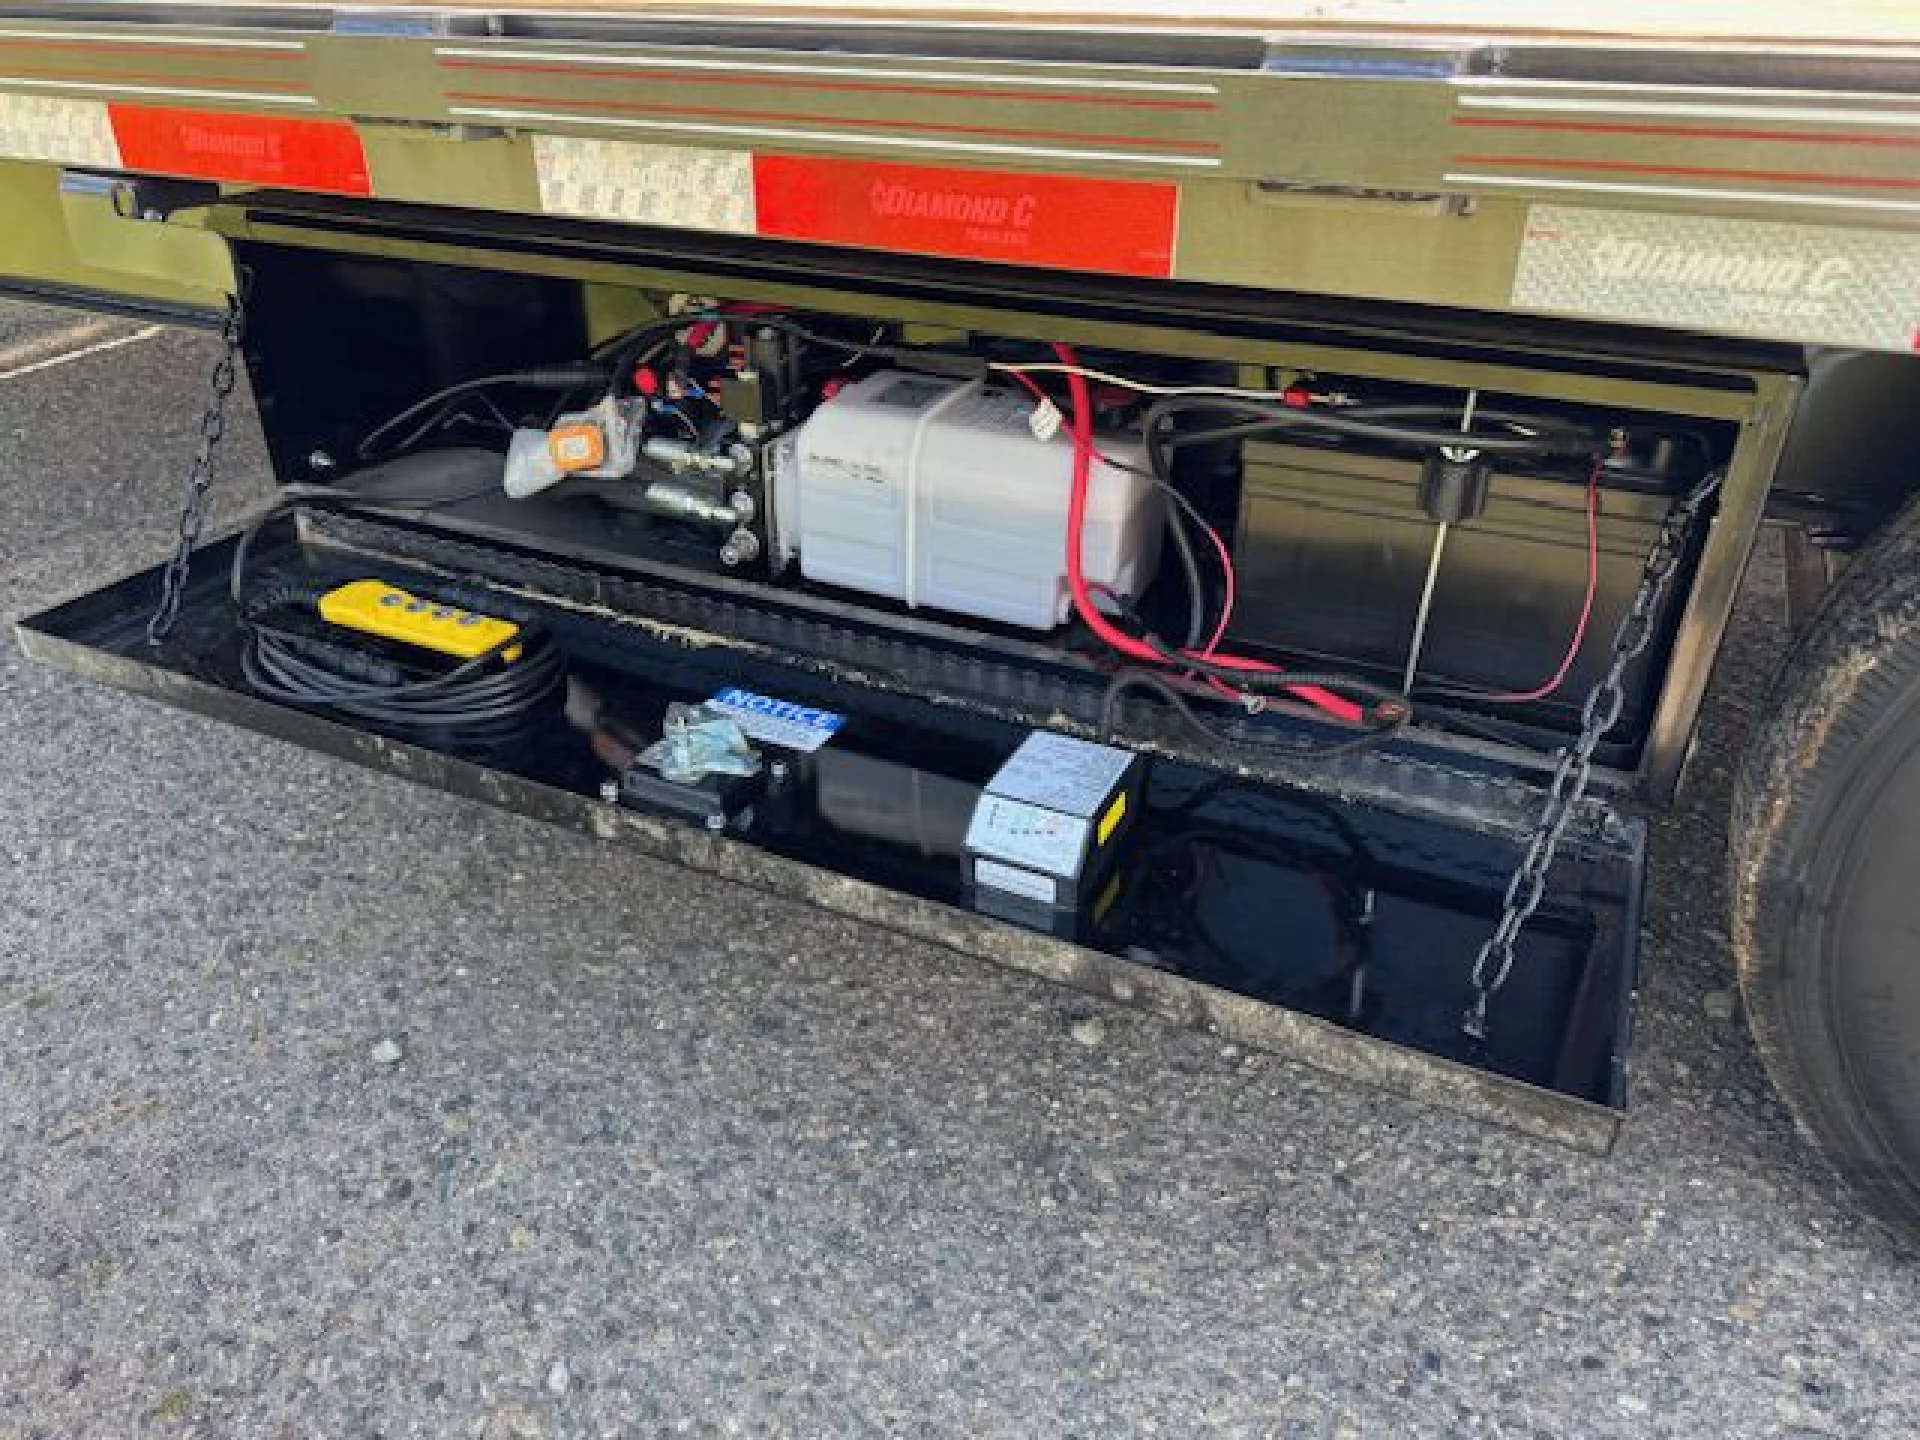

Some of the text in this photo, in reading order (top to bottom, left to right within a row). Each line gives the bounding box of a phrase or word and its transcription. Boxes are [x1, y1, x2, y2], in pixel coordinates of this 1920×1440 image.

[882, 185, 1037, 228] DIAMOND C
[1614, 241, 1804, 292] DIAMOND
